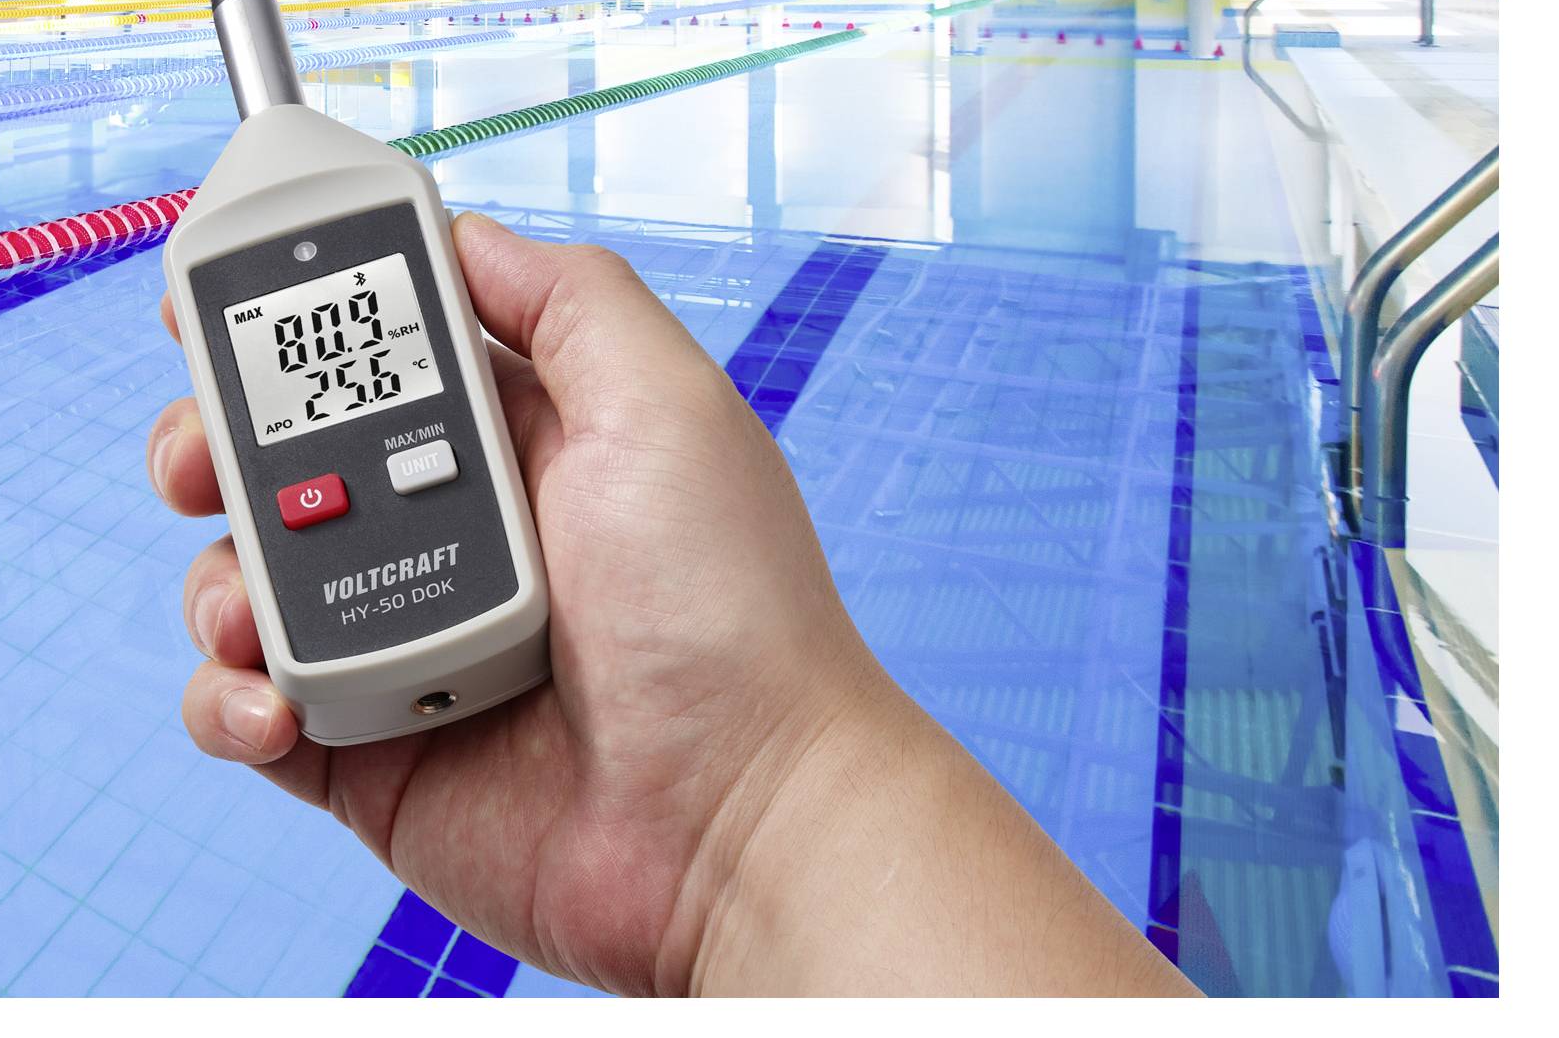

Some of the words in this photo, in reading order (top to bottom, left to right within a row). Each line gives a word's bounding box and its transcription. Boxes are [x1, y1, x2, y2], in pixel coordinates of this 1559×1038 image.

[234, 306, 264, 325] MAX
[274, 289, 383, 373] 80.9
[387, 322, 420, 340] %RH
[304, 348, 401, 422] 25.6
[412, 358, 429, 370] °C
[265, 418, 293, 435] APO
[384, 422, 445, 451] MAX/MIN
[399, 452, 439, 477] UNIT
[323, 542, 460, 605] VOLTCRAFT
[341, 593, 406, 625] HY-50
[411, 577, 456, 604] DOK
